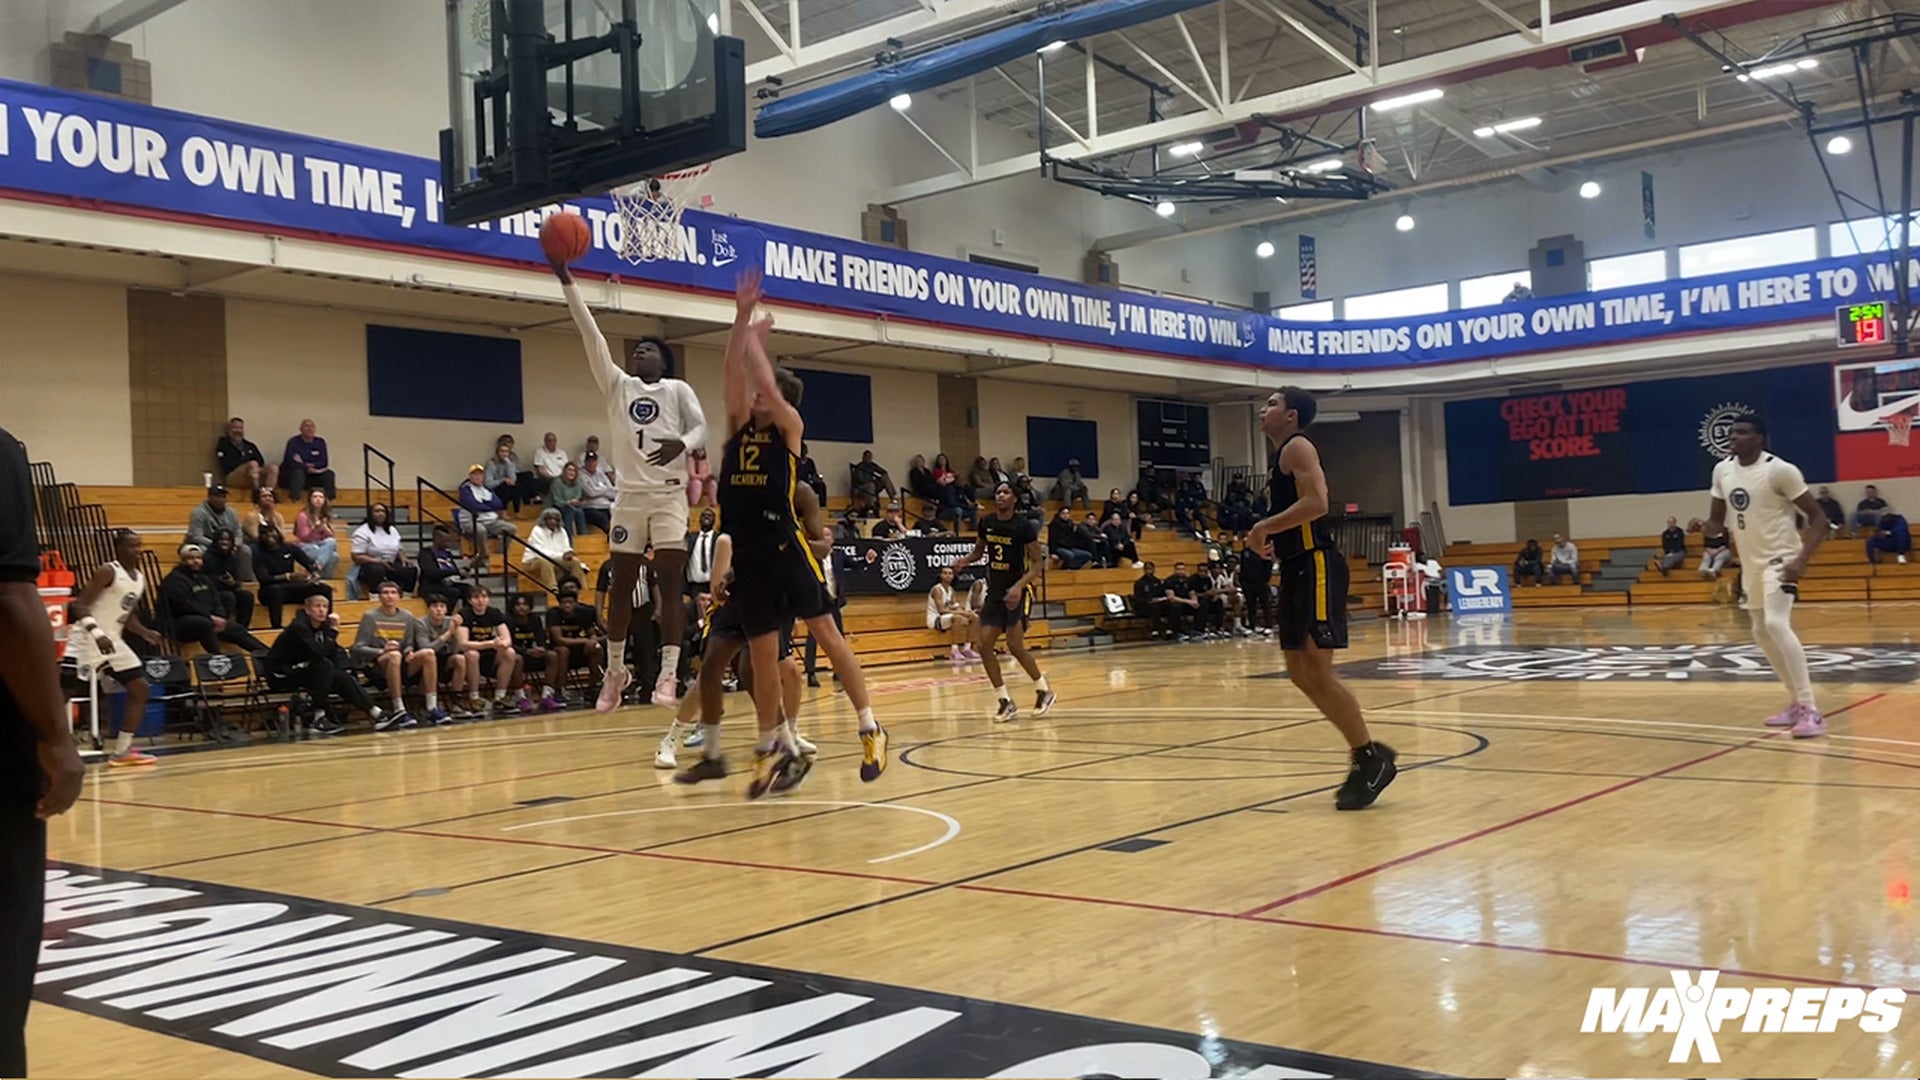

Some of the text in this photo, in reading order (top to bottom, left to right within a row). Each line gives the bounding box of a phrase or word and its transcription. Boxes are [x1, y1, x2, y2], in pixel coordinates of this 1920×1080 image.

[22, 106, 170, 181] YOUR
[181, 136, 296, 200] OWN
[304, 157, 416, 228] TIME,
[765, 240, 837, 286] MAKE
[842, 254, 930, 301] FRIENDS
[934, 272, 965, 307] ON
[968, 277, 1022, 316] YOUR
[1025, 288, 1069, 323] OWN
[1071, 295, 1116, 336] TIME,
[1119, 302, 1147, 334] I'M
[1150, 308, 1187, 340] HERE
[1188, 315, 1207, 343] TO
[1208, 317, 1242, 348] WIN.
[1268, 326, 1314, 355] MAKE
[1317, 326, 1411, 355] FRIENDS
[1416, 322, 1452, 349] ON
[1458, 312, 1525, 345] YOUR
[1532, 302, 1596, 335] OWN
[1600, 292, 1675, 326] TIME,
[1680, 284, 1731, 317] I'M
[1738, 273, 1811, 310] HERE
[1816, 267, 1858, 299] TO
[1849, 305, 1882, 322] 2:54
[1856, 318, 1882, 344] 19
[1501, 388, 1628, 421] CHECK YOUR
[1510, 411, 1620, 440] EGO AT THE
[636, 429, 644, 449] 1
[1530, 435, 1600, 460] SCORE.
[739, 445, 760, 470] 12
[1737, 513, 1745, 530] 6
[994, 544, 1003, 561] 3
